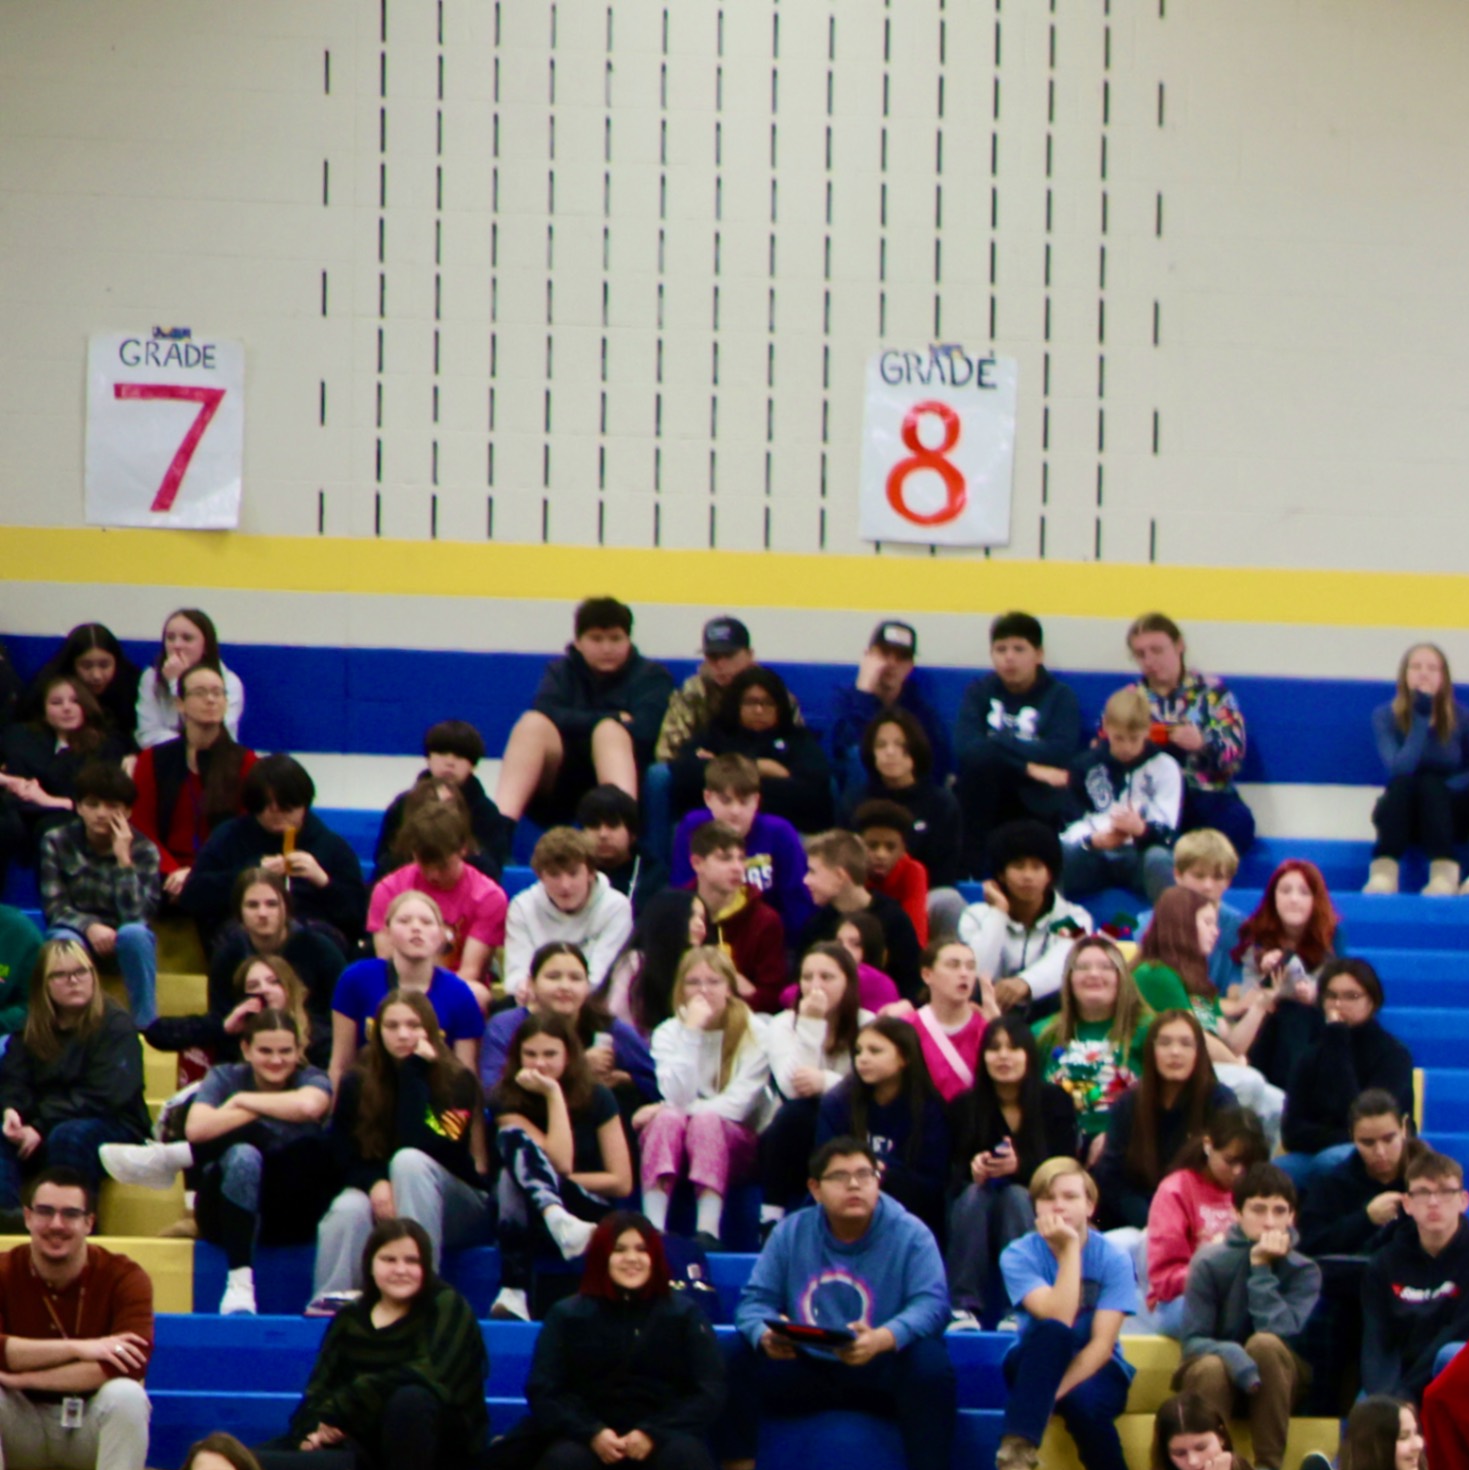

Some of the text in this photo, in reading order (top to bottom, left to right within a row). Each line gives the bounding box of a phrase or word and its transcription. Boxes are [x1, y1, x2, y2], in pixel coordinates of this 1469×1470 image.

[119, 340, 216, 369] GRADE
[880, 349, 998, 389] GRADE
[114, 382, 226, 512] 7
[886, 400, 968, 526] 8
